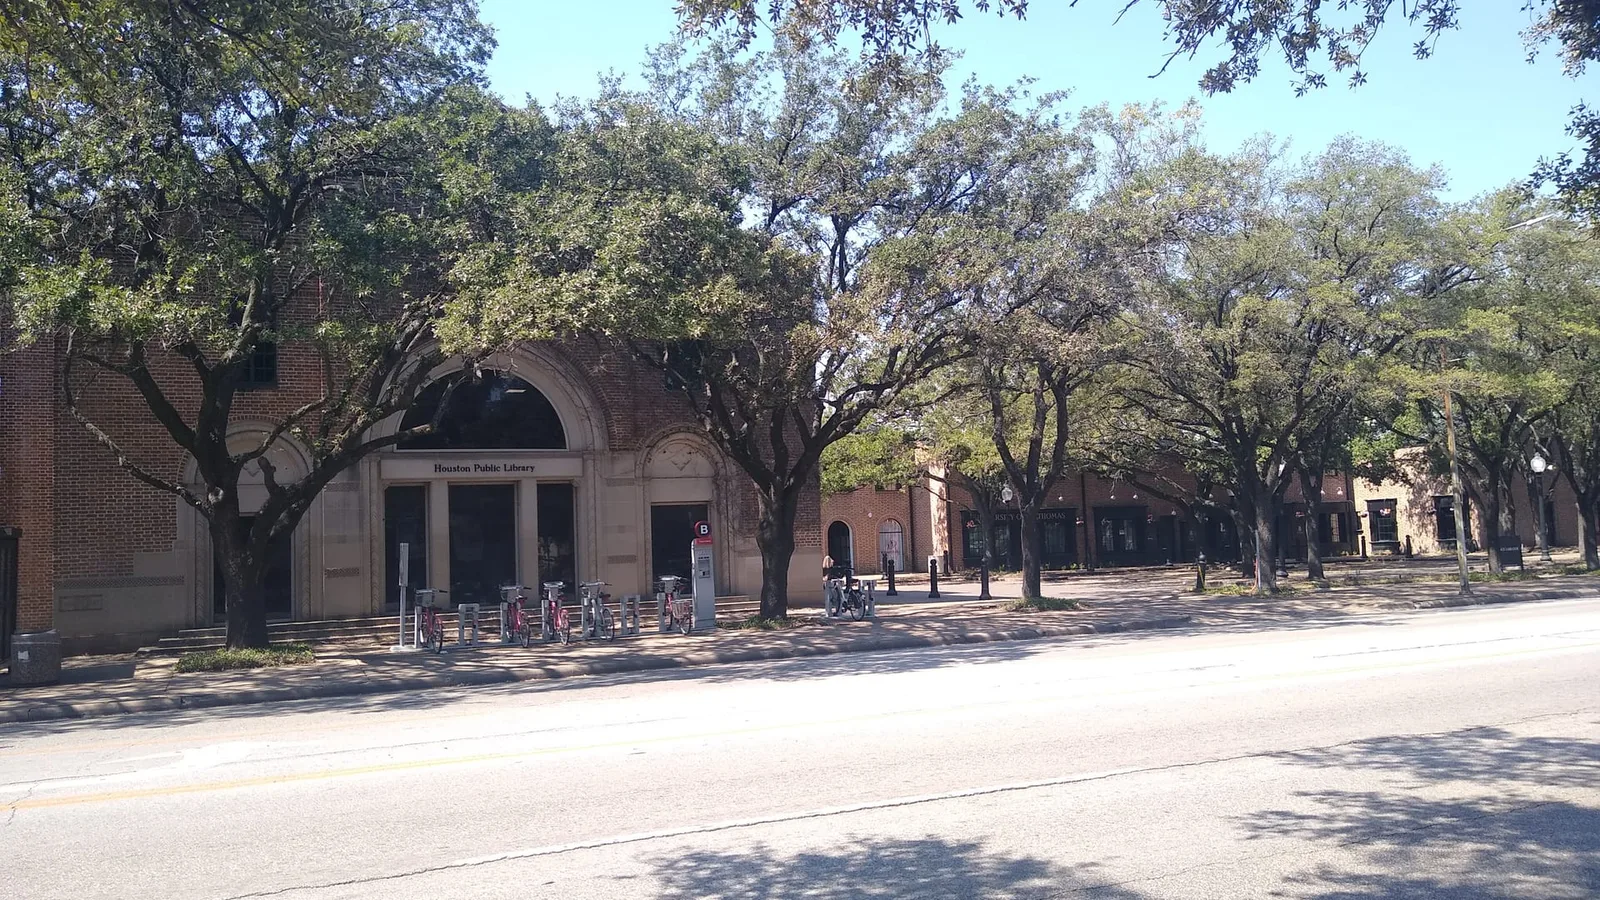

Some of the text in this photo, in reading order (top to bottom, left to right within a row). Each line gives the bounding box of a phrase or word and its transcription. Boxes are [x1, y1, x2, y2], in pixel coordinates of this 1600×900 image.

[434, 463, 535, 473] Houston Public Library
[1037, 512, 1066, 520] THOMAS
[700, 525, 708, 535] B
